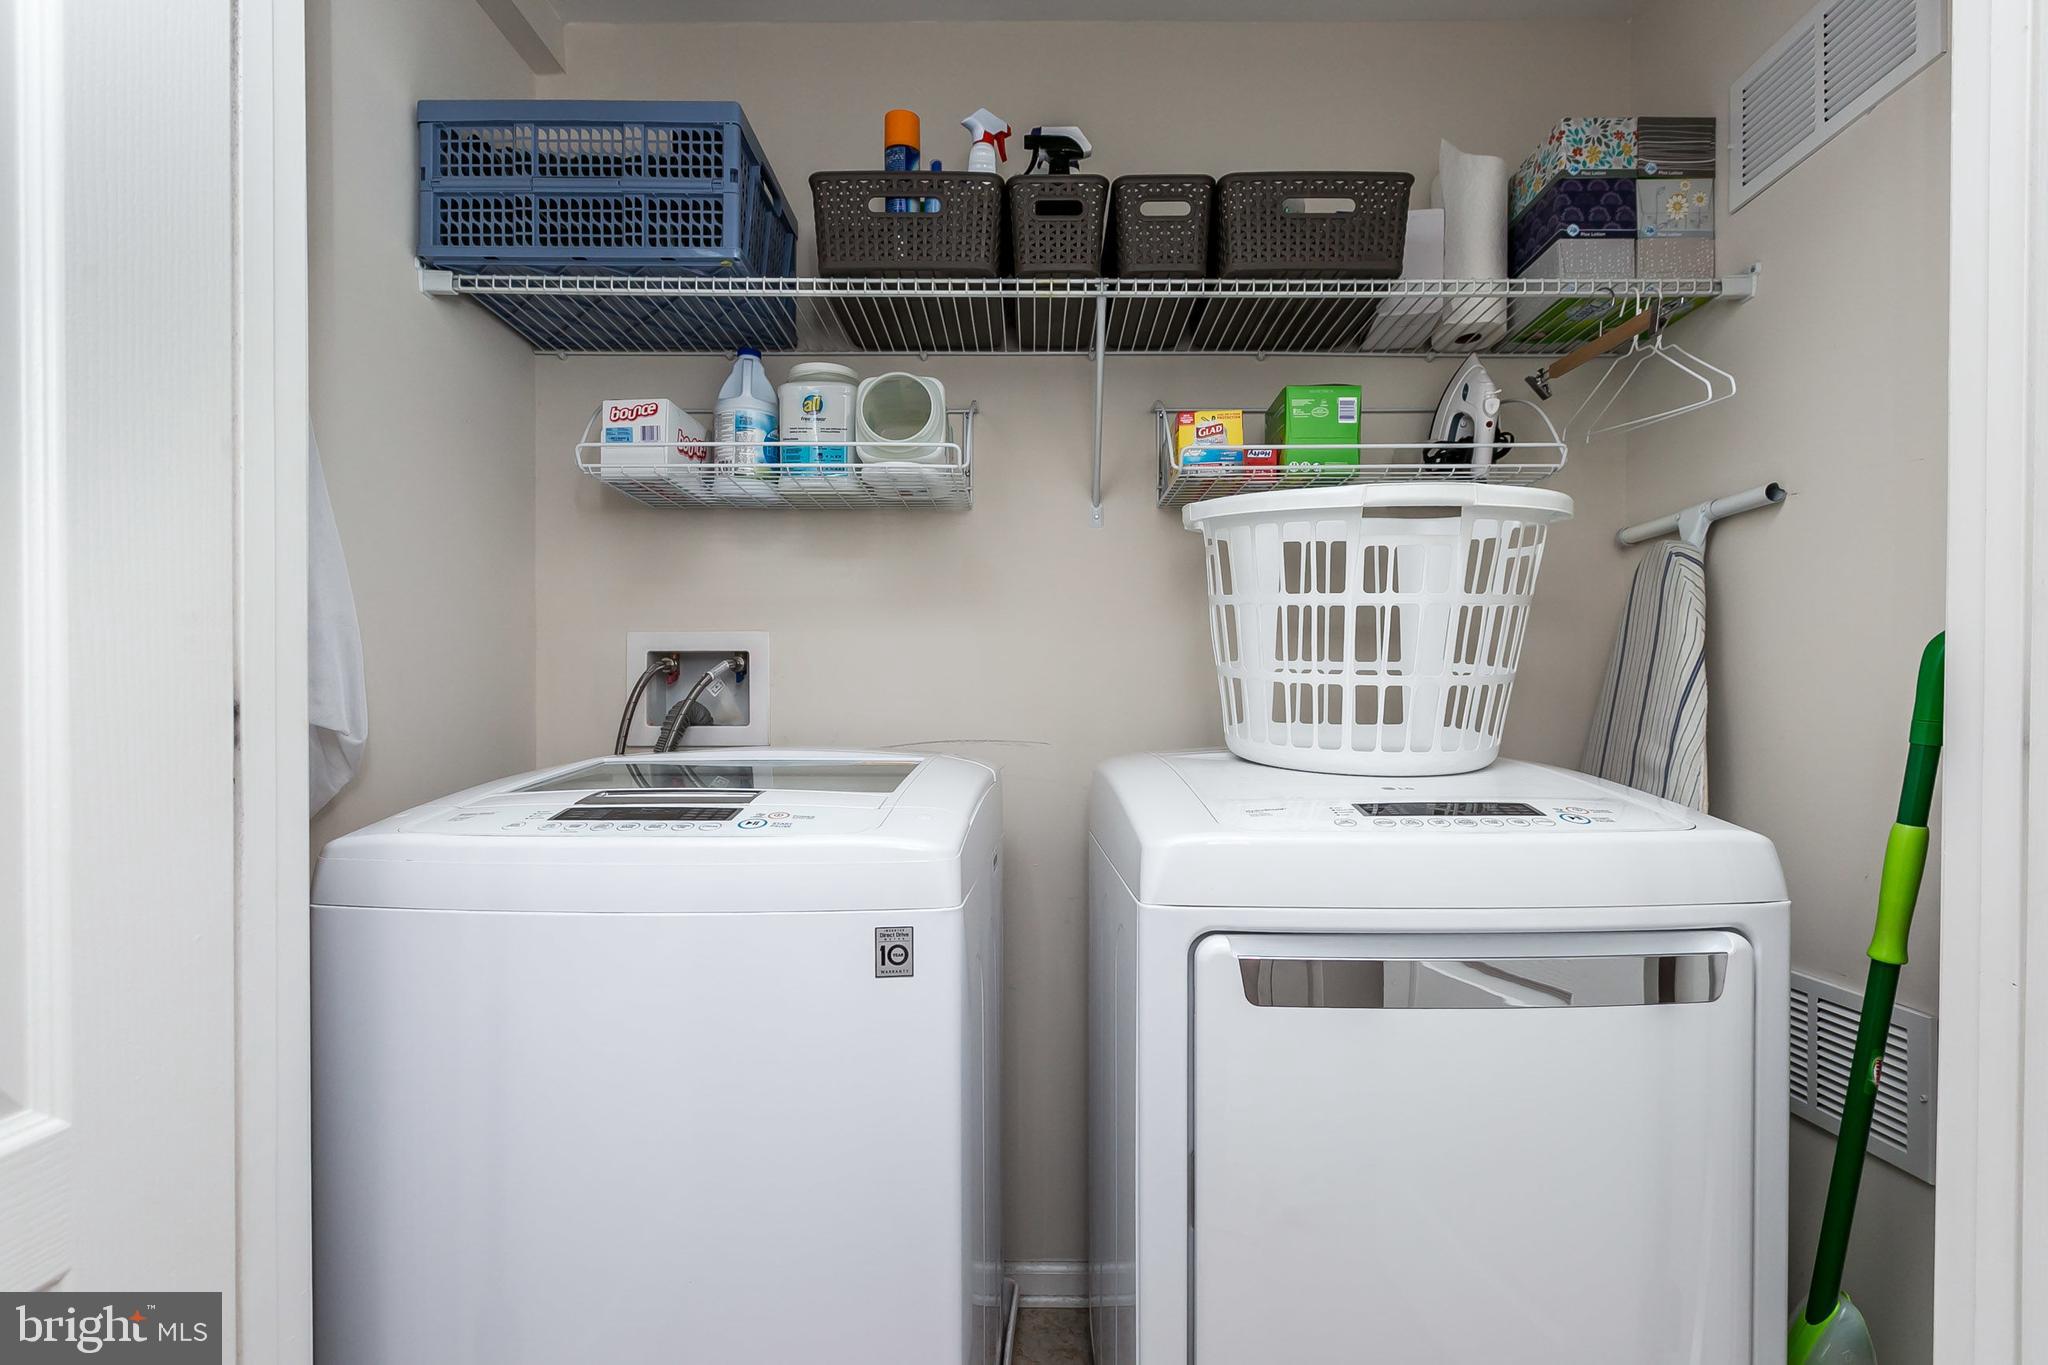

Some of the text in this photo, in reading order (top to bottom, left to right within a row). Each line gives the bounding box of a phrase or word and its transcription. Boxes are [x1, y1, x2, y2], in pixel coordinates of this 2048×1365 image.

[610, 402, 658, 422] bounce
[802, 395, 822, 413] all
[1198, 424, 1223, 436] GLAD
[1247, 449, 1272, 458] Hefty
[880, 944, 909, 966] 10
